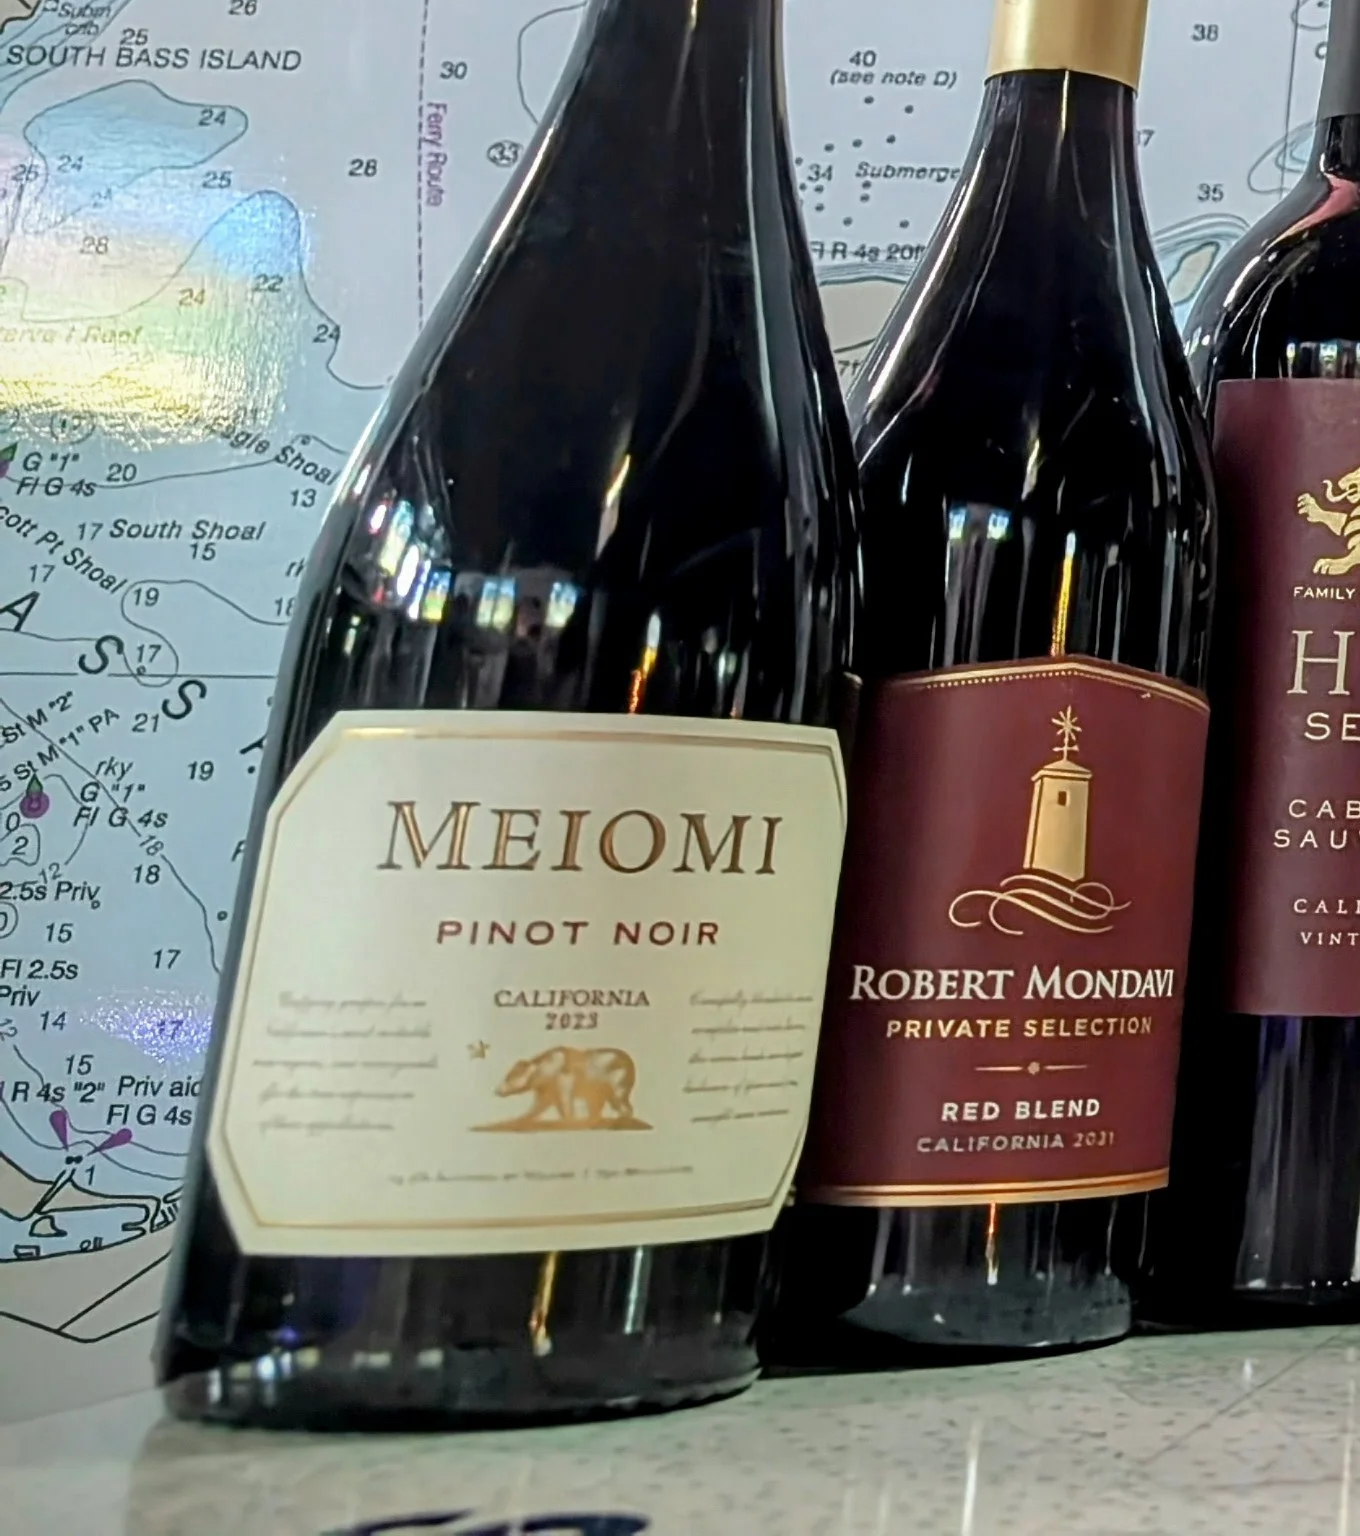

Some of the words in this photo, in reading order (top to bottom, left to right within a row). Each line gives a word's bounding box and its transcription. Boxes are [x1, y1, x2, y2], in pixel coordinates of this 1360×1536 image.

[7, 45, 105, 66] SOUTH
[117, 47, 189, 69] BASS
[200, 50, 302, 71] ISLAND
[829, 68, 876, 87] (see
[880, 69, 926, 85] note
[932, 69, 957, 88] D)
[425, 102, 447, 151] Ferry
[425, 152, 446, 208] Route
[22, 452, 41, 472] G
[50, 453, 79, 472] "1"
[107, 464, 137, 482] 20
[109, 519, 182, 539] South
[192, 520, 266, 541] Shoal
[37, 531, 63, 556] Pt
[63, 547, 128, 595] Shoal
[1293, 585, 1357, 602] FAMILY
[132, 713, 159, 732] 21
[376, 800, 783, 875] MEIOMI
[0, 882, 48, 901] 2.5s
[54, 881, 99, 904] Priv
[436, 920, 589, 946] PINOT
[614, 921, 720, 946] NOIR
[0, 960, 22, 979] Fl
[27, 959, 78, 980] 2.5s
[849, 964, 1014, 1001] ROBERT
[1022, 964, 1174, 1001] MONDAVI
[494, 989, 650, 1009] CALIFORNIA
[886, 1019, 1011, 1039] PRIVATE
[1023, 1016, 1153, 1038] SELECTION
[118, 1076, 164, 1098] Priv
[107, 1104, 130, 1125] Fl
[136, 1104, 156, 1126] G
[164, 1106, 192, 1126] 4s
[941, 1101, 1001, 1122] RED
[1014, 1098, 1101, 1120] BLEND
[916, 1133, 1065, 1153] CALIFORNIA
